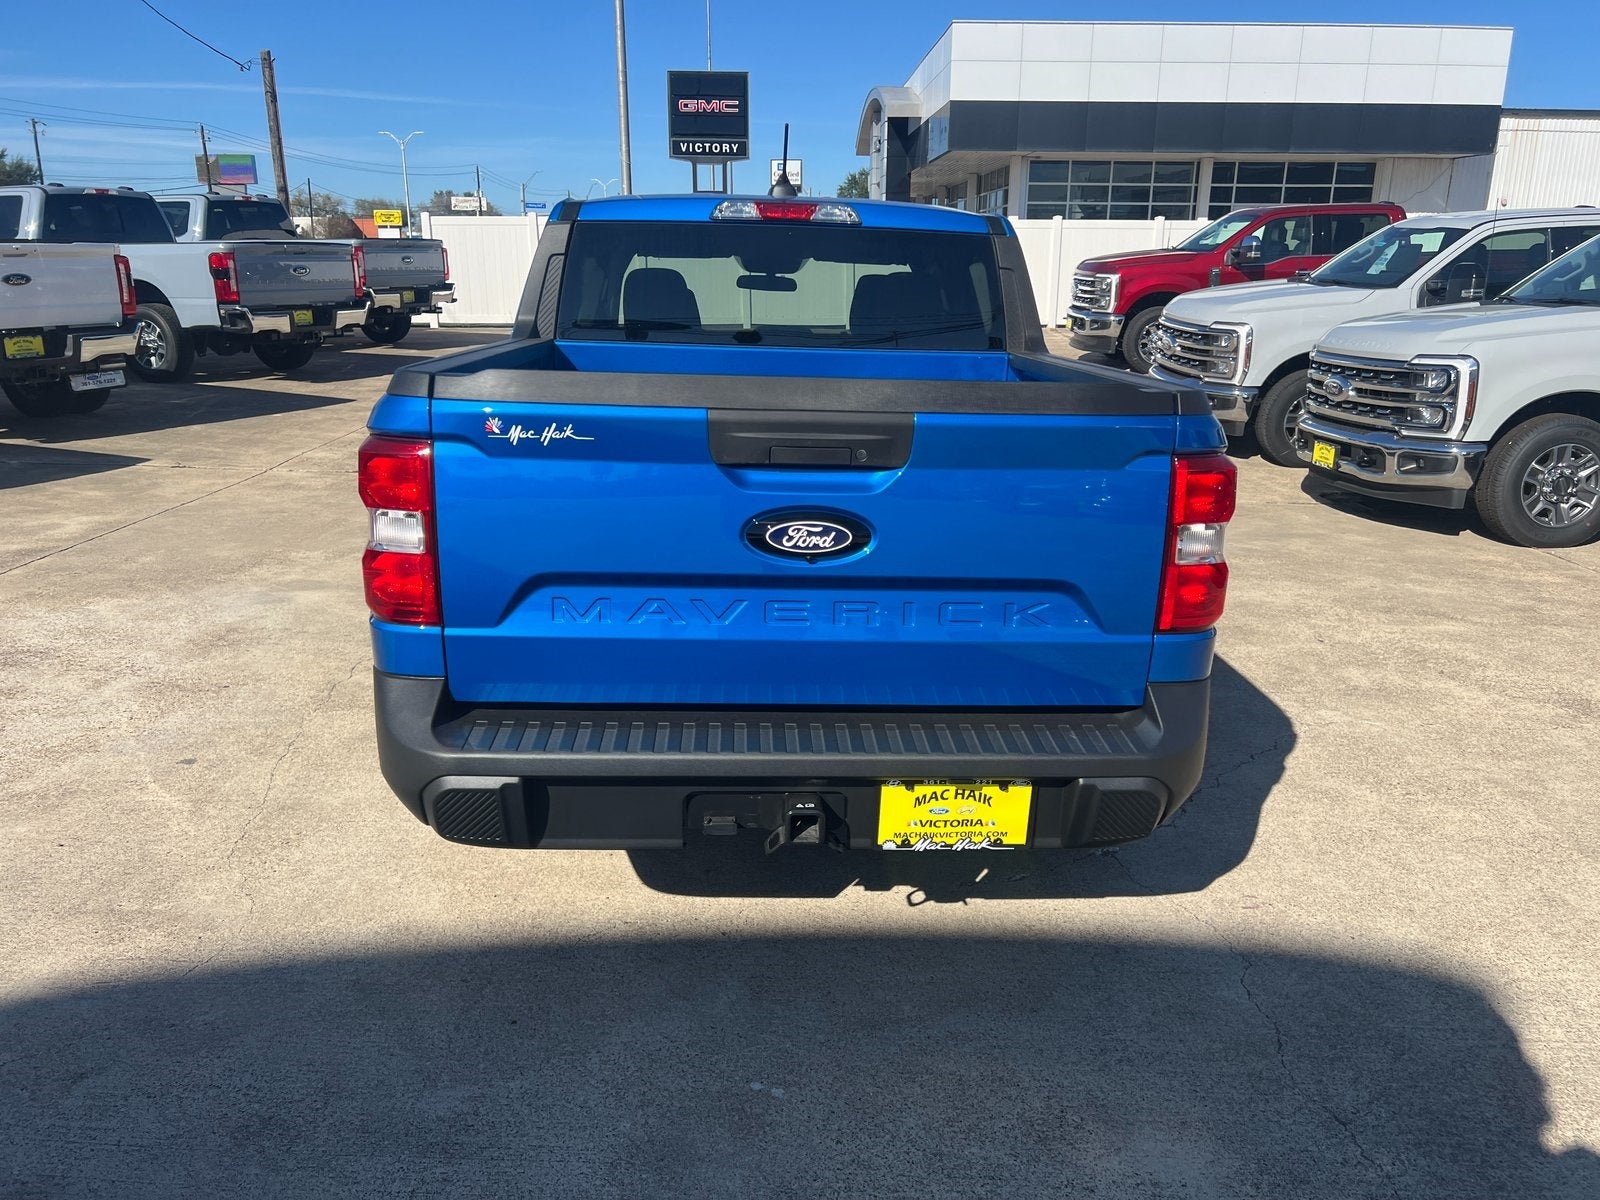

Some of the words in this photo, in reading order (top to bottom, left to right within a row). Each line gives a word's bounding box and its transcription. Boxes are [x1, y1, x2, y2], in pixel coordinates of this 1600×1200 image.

[678, 99, 739, 113] GMC
[680, 142, 739, 153] VICTORY
[507, 424, 538, 446] Mac
[540, 422, 583, 447] Haik
[782, 525, 836, 548] Ford
[550, 596, 1052, 628] MAVERICK
[913, 789, 950, 808] MAC
[954, 789, 993, 807] HAIK
[919, 818, 984, 828] VICTORIA
[893, 830, 1008, 839] MACHAIKVICTORIA.COM
[912, 837, 950, 852] Mac
[952, 837, 997, 851] Haik
